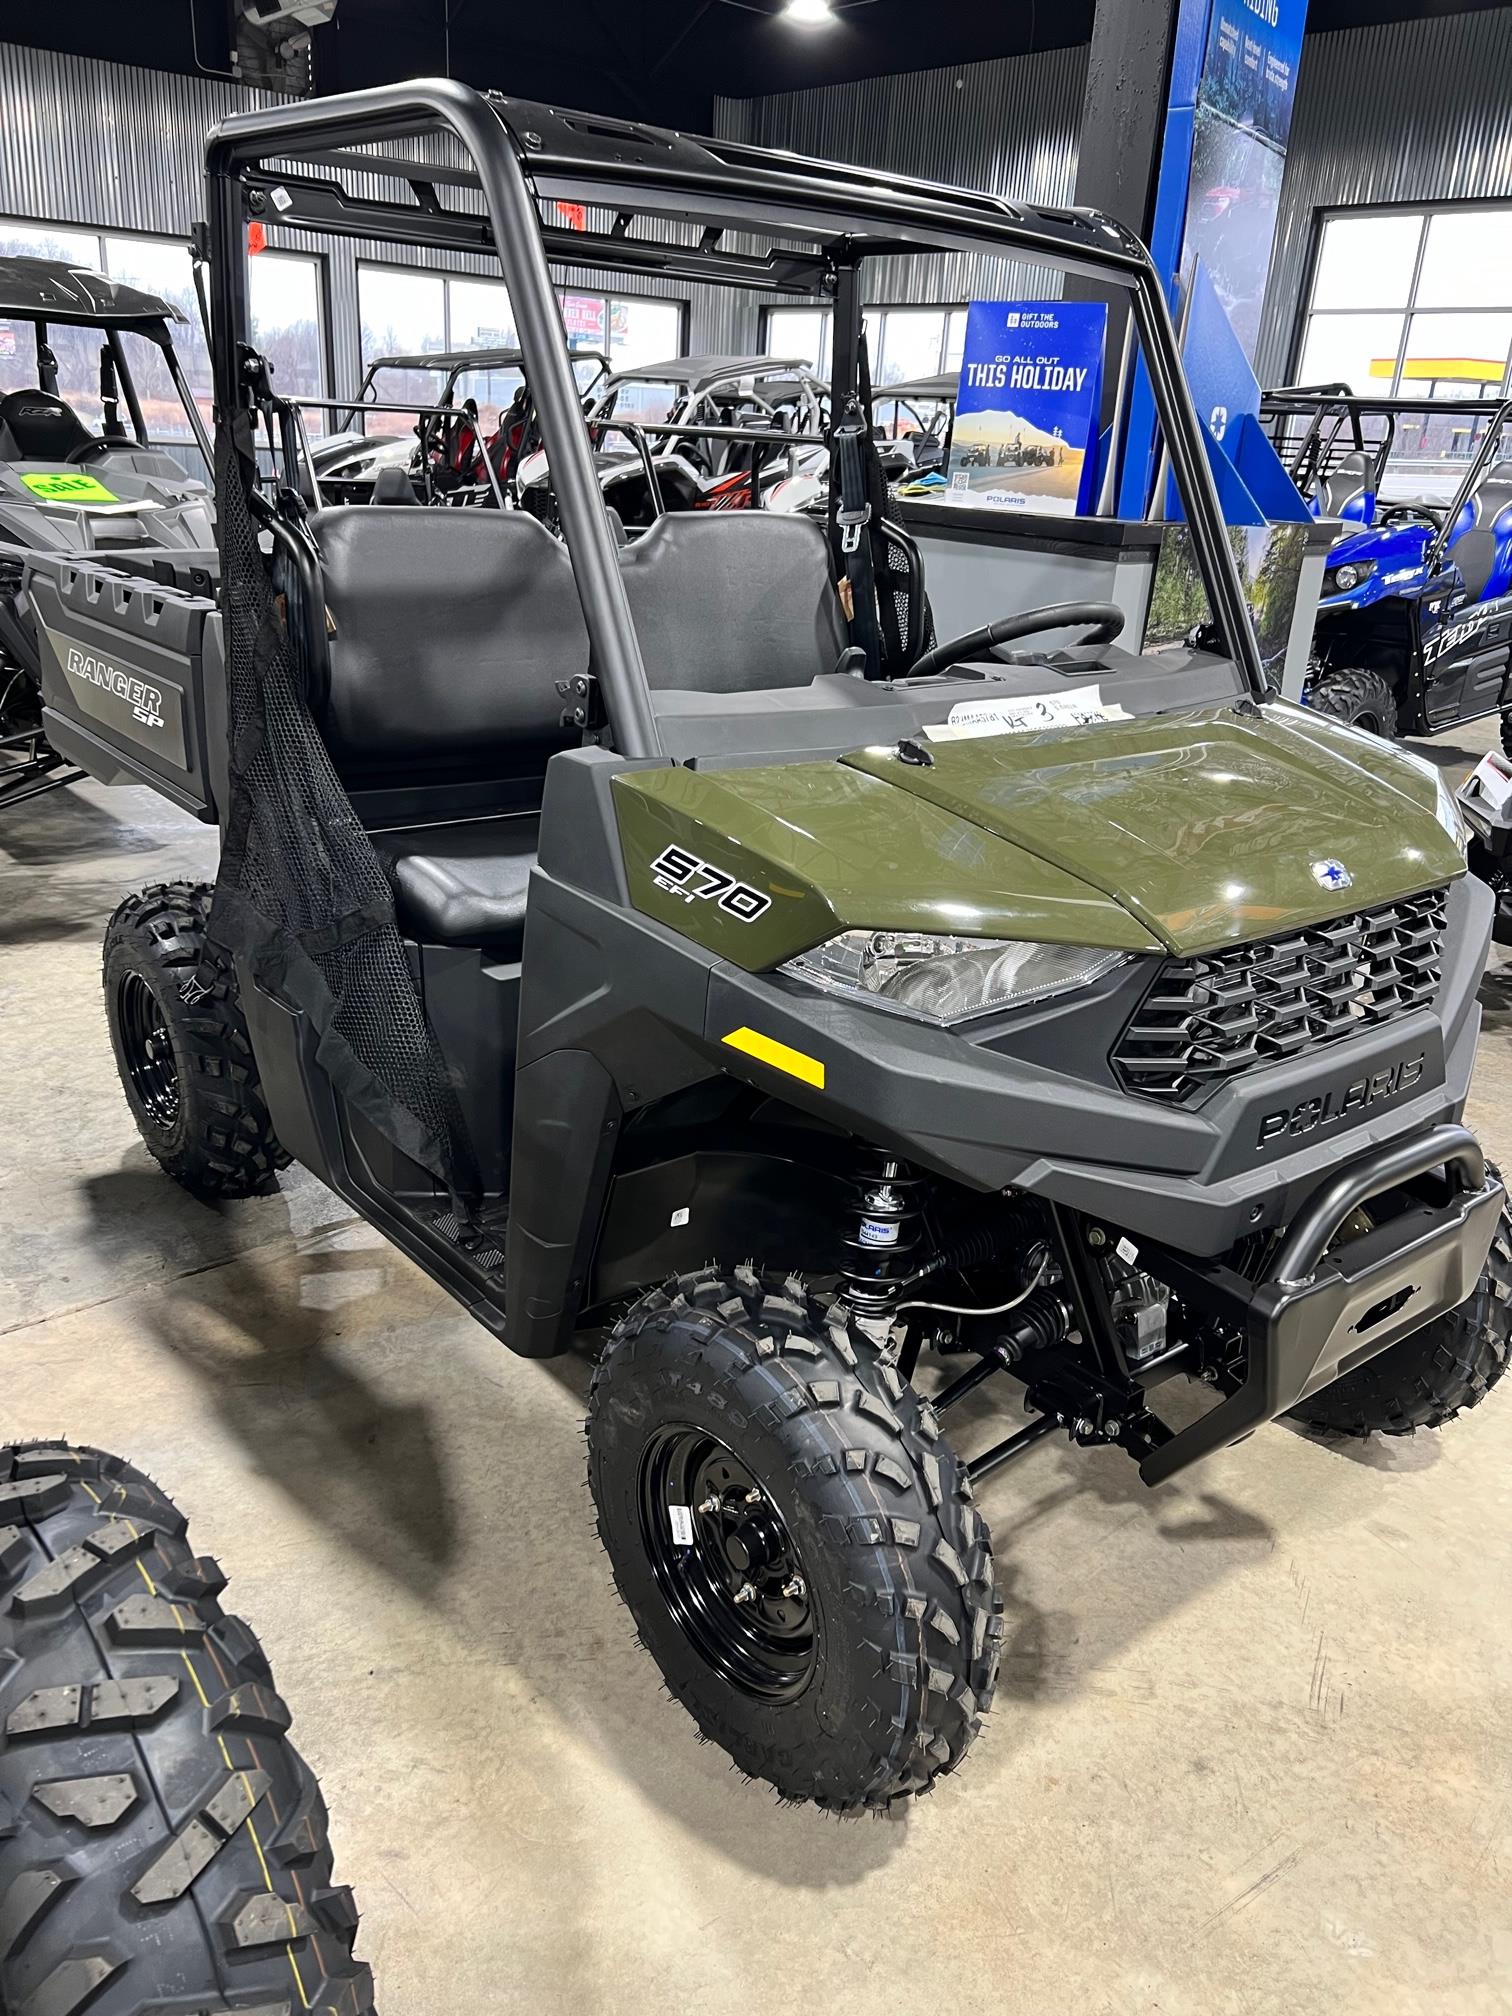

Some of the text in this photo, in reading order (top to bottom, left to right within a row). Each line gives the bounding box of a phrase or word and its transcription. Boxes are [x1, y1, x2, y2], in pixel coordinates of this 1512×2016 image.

[1020, 321, 1059, 329] OUTDOORS
[1022, 313, 1054, 321] GIFT THE
[995, 355, 1060, 365] GO ALL OUT
[967, 363, 1088, 392] THIS HOLIDAY
[32, 479, 97, 493] SALE
[986, 495, 1026, 505] POLARIS
[67, 648, 162, 717] RANGER
[132, 706, 165, 728] SP
[649, 843, 772, 923] 570
[653, 875, 696, 904] EFI
[1255, 1052, 1425, 1150] POLARIS
